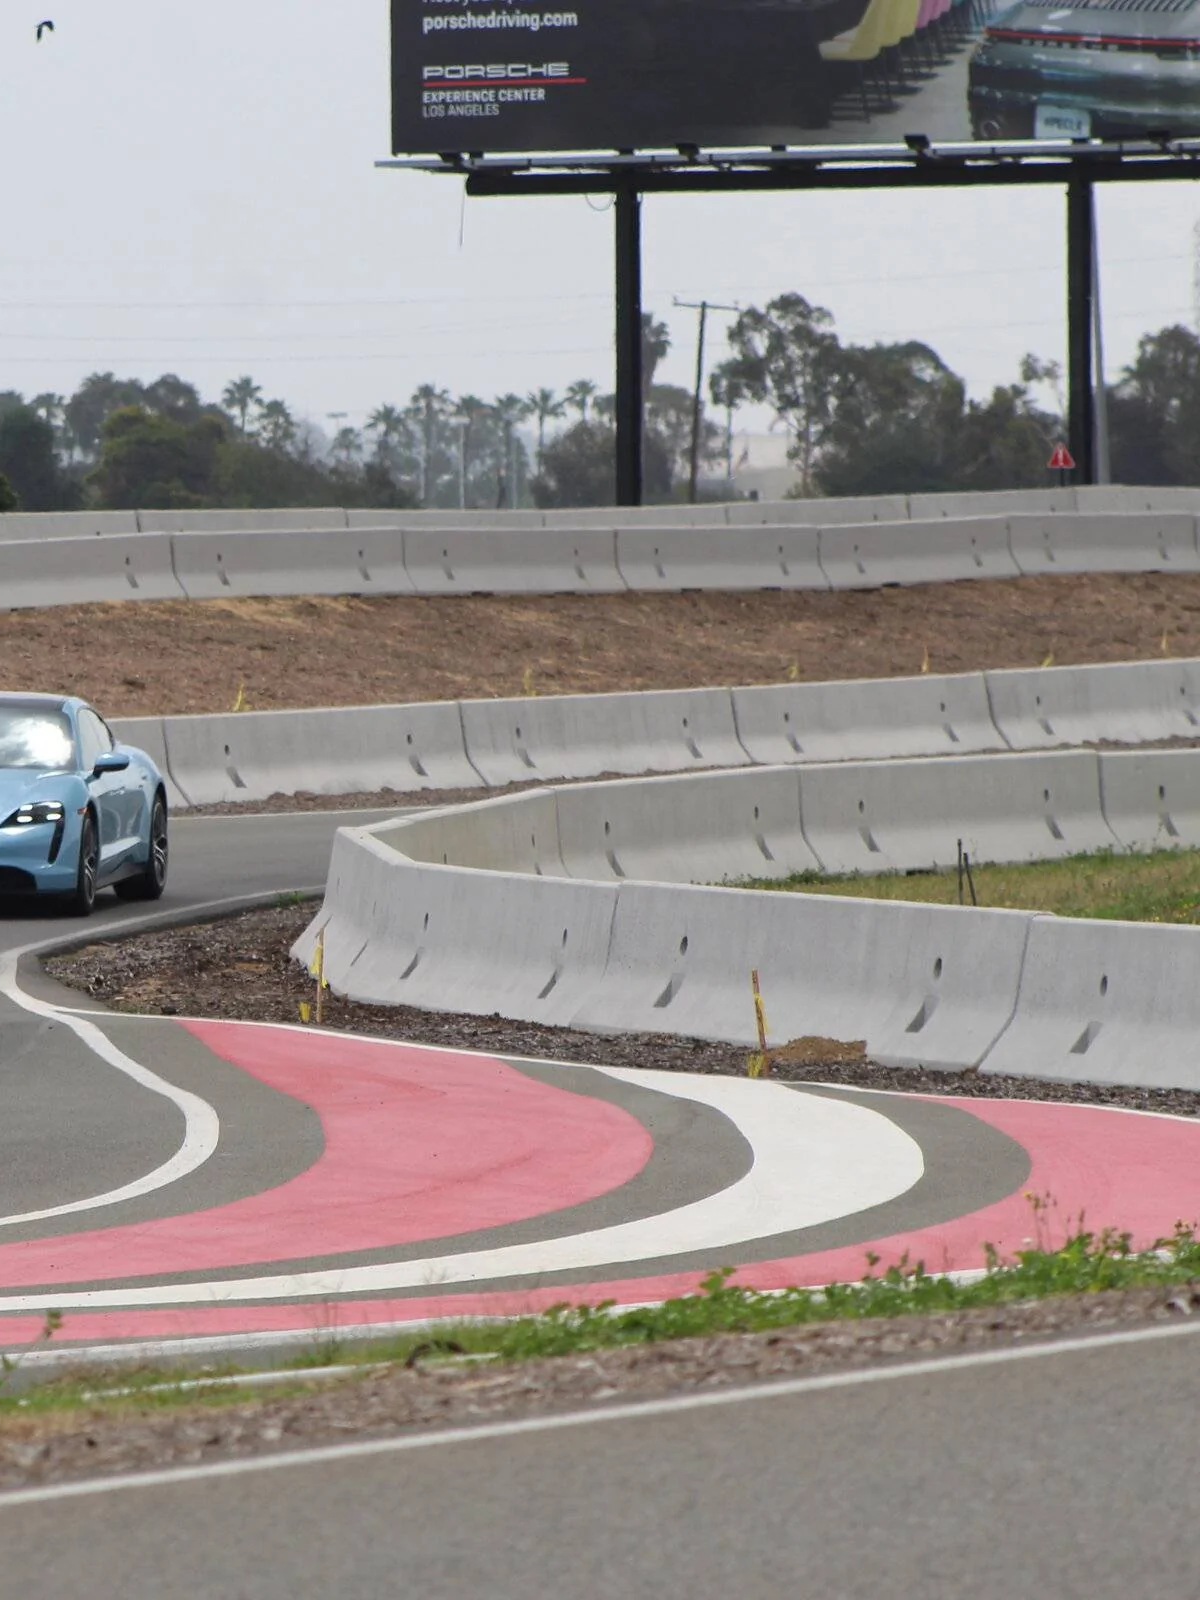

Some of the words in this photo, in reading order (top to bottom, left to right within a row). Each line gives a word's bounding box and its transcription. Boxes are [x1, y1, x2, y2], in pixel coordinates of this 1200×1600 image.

[422, 10, 578, 34] porschedriving.com
[422, 62, 570, 79] PORSCHE
[422, 89, 497, 103] EXPERIENCE
[498, 88, 546, 101] CENTER
[422, 105, 445, 118] LOS
[447, 103, 500, 117] ANGELES
